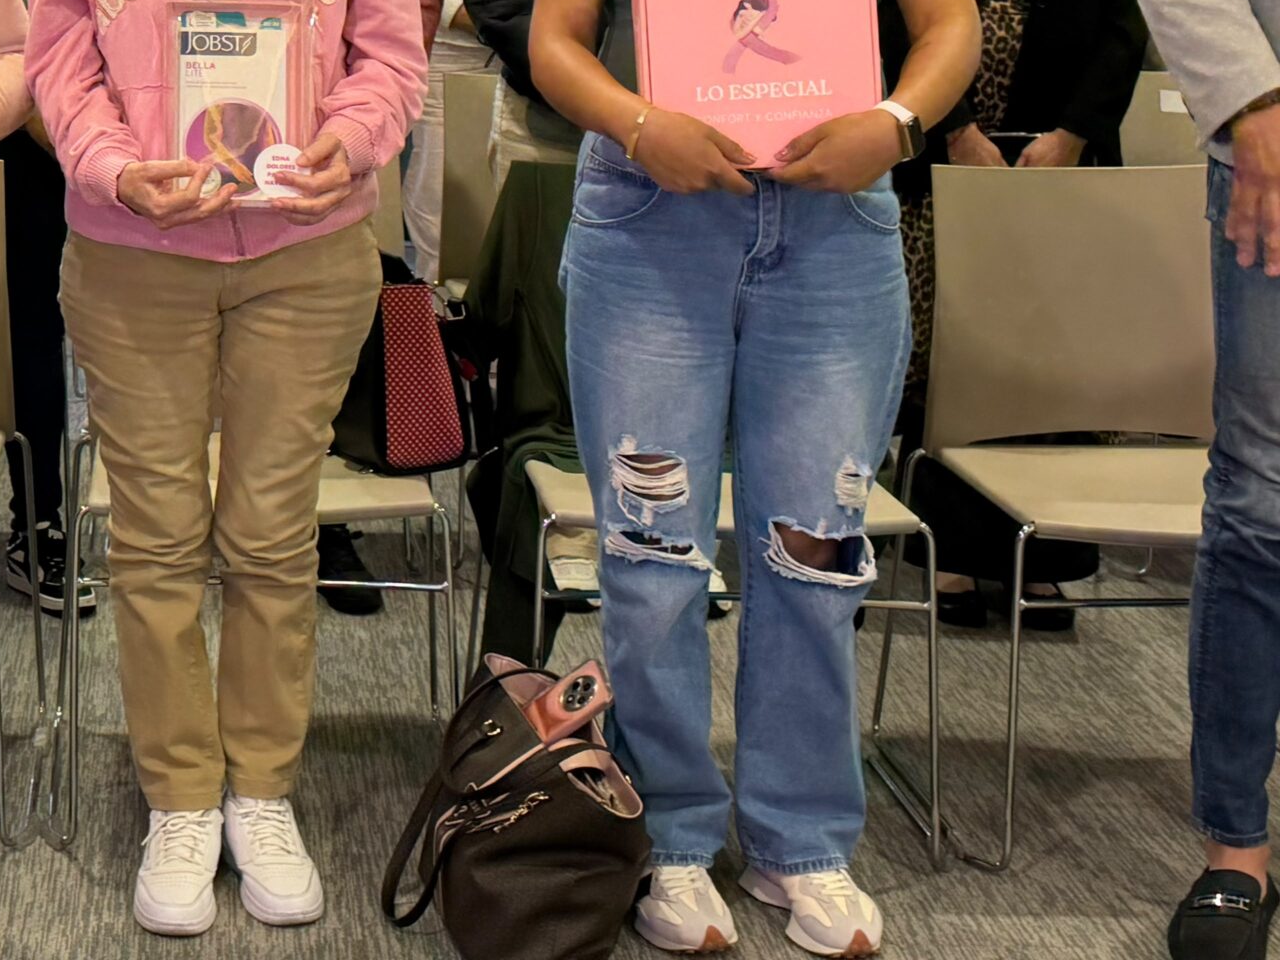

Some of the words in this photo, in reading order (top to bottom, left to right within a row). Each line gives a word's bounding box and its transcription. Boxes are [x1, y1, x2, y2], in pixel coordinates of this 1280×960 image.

[185, 31, 244, 53] JOBST
[185, 61, 216, 69] BELLA
[696, 85, 724, 102] LO
[728, 79, 833, 100] ESPECIAL
